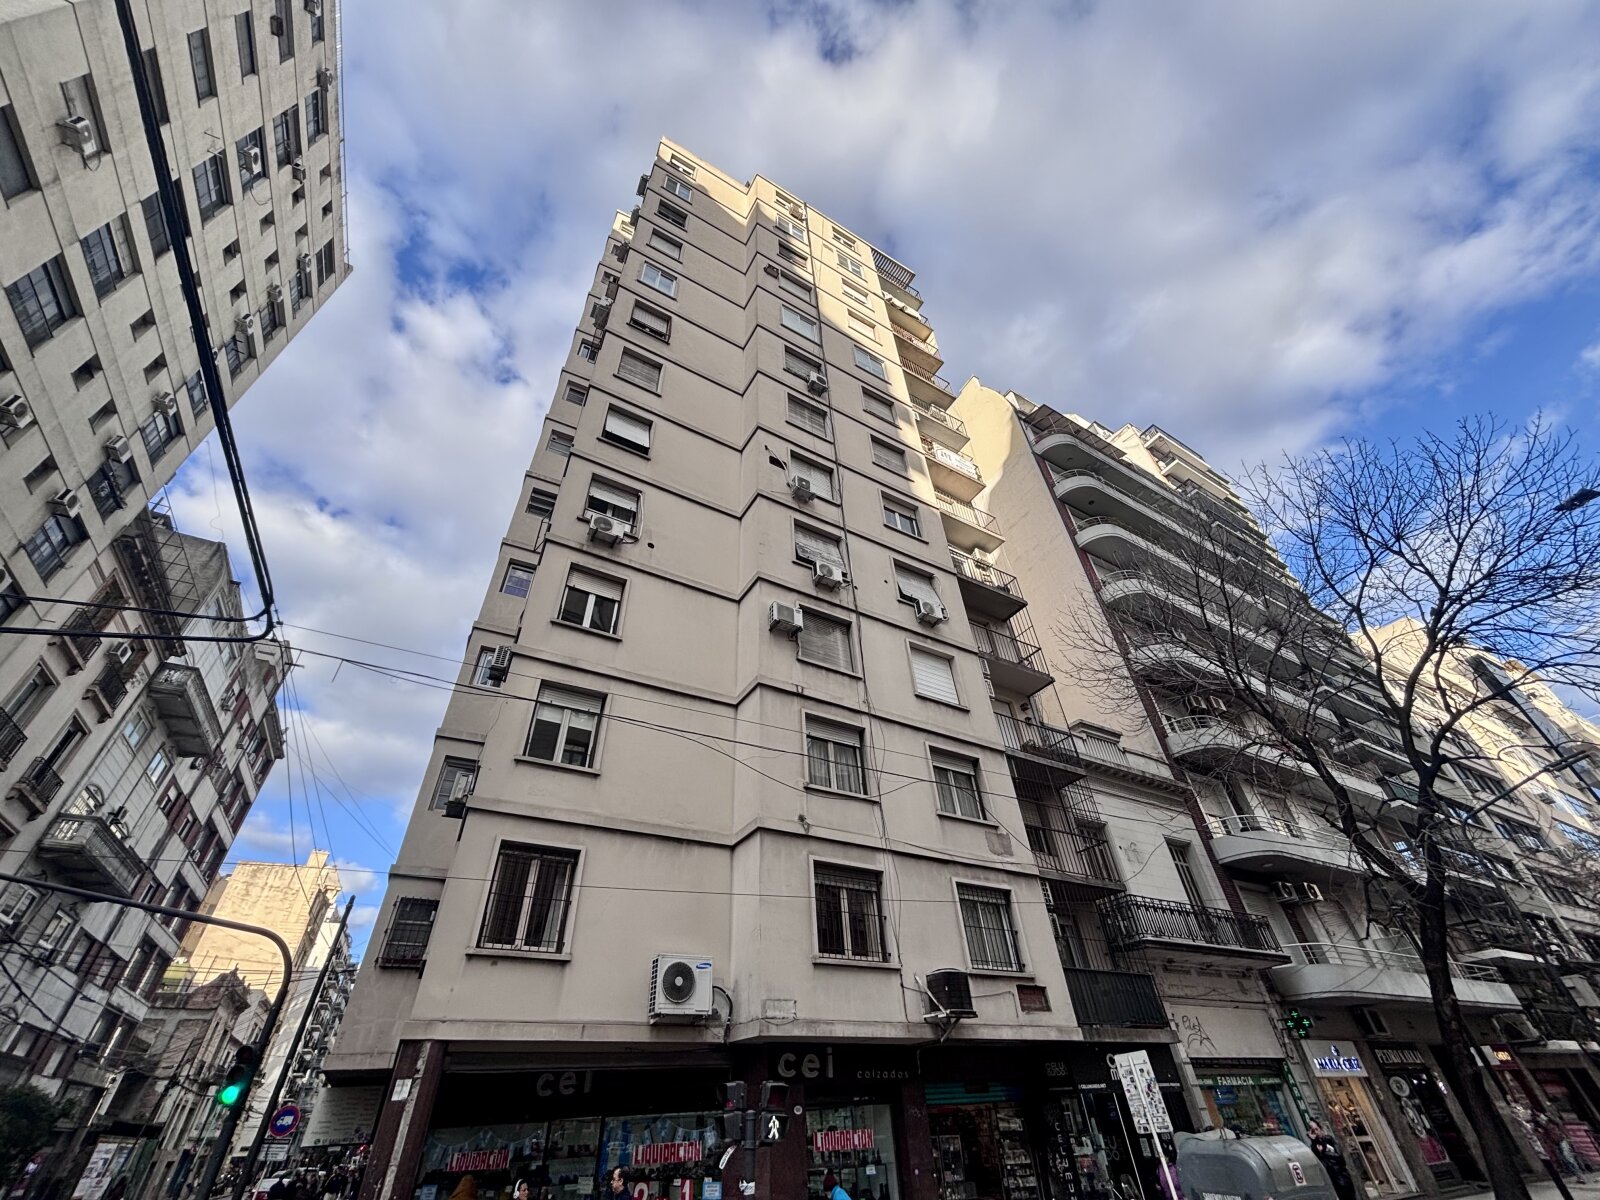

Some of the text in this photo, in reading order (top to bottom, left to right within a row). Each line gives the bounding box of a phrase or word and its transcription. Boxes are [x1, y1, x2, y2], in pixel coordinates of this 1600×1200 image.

[777, 1046, 909, 1079] cei calzados
[1216, 1076, 1255, 1086] FARMACIA
